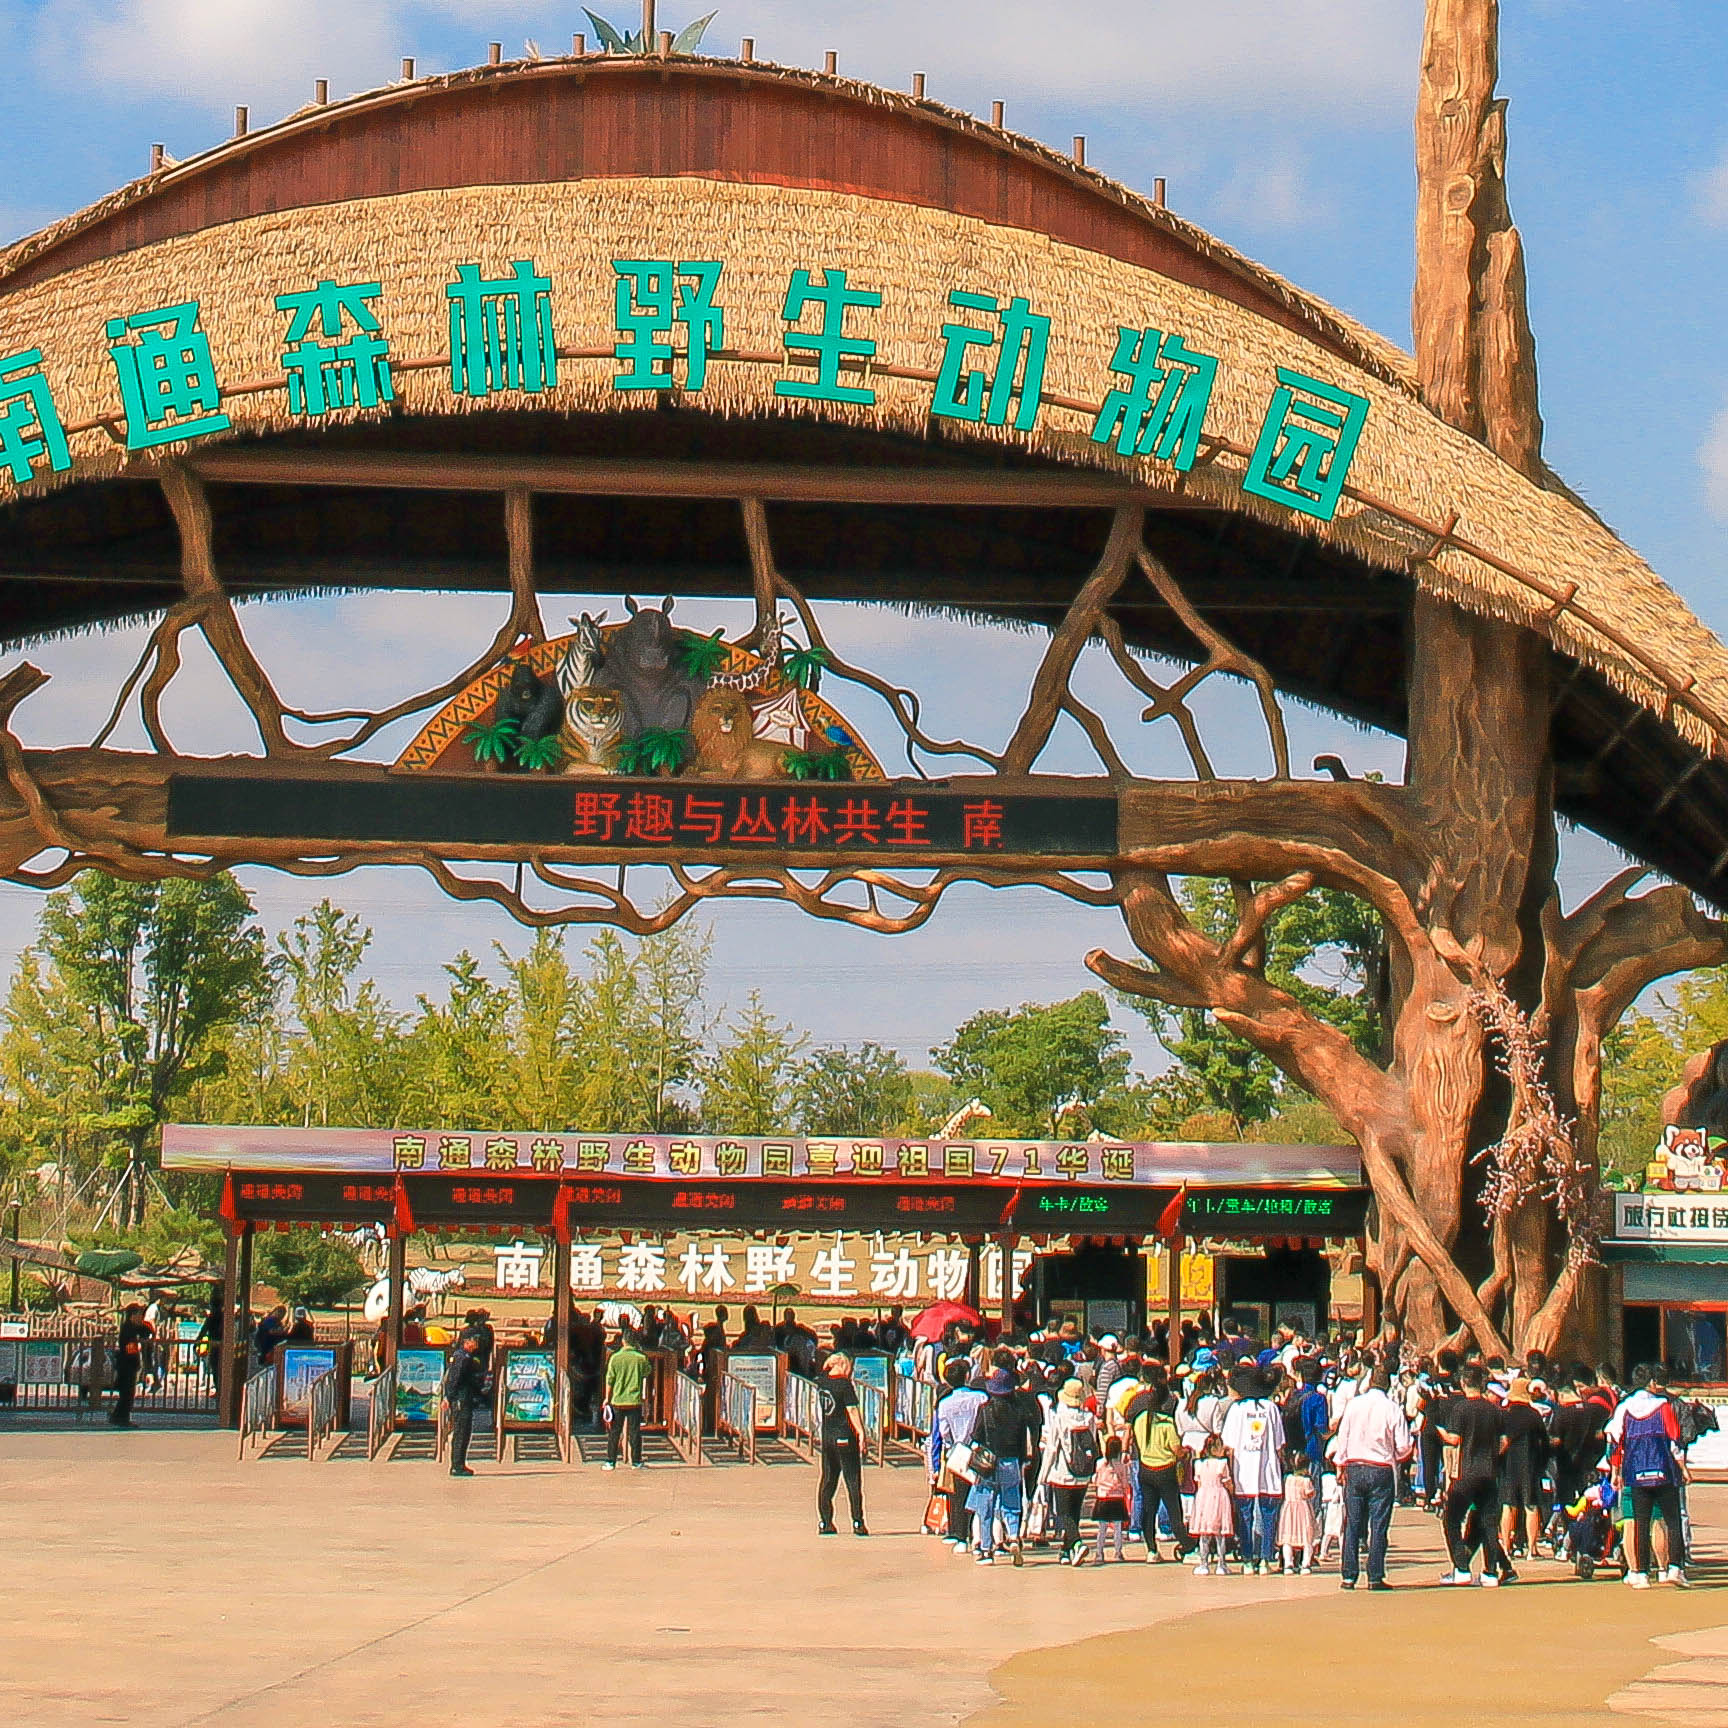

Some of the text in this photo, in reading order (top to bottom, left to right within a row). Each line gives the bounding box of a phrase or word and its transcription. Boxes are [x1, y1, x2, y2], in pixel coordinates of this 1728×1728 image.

[573, 791, 1004, 849] 野趣与丛林共生 南
[393, 1135, 1135, 1180] 南通森林野生动物园喜迎祖国71华诞
